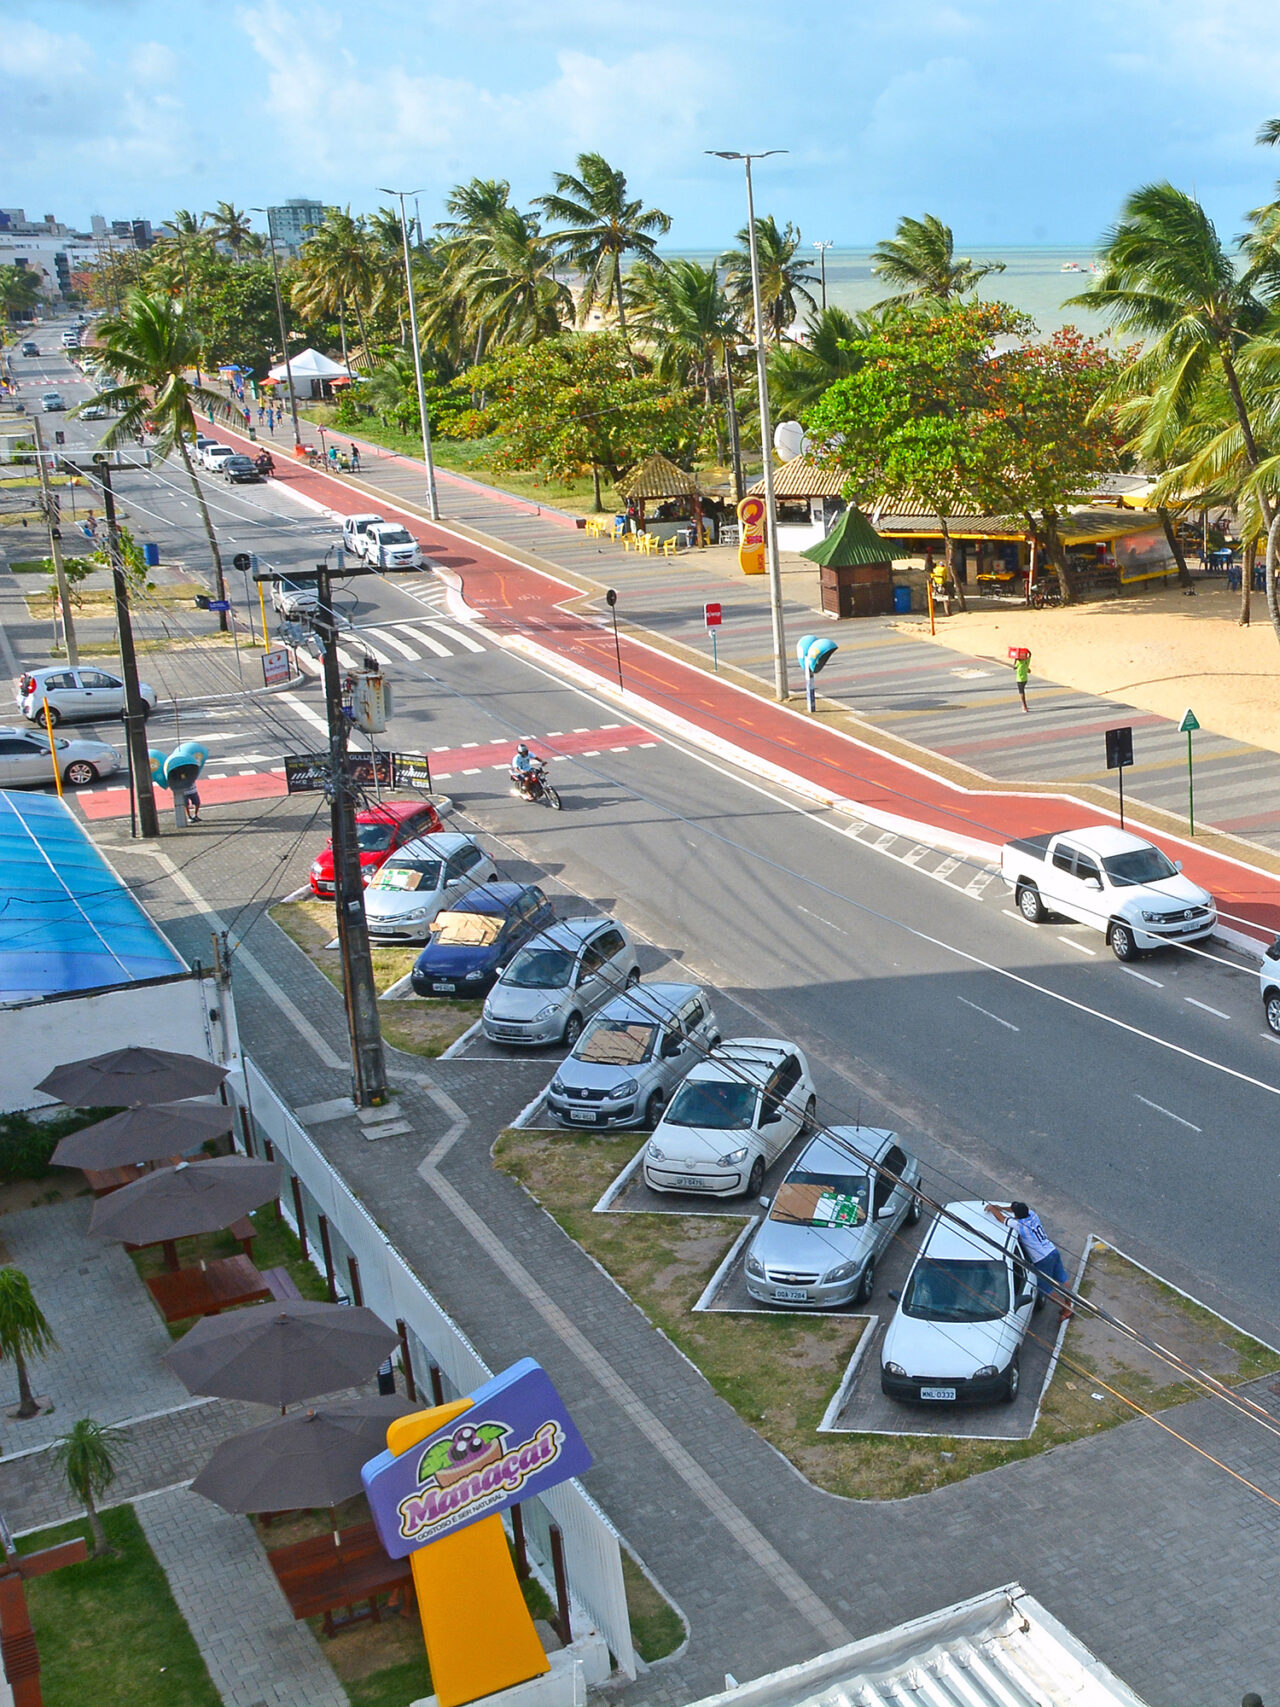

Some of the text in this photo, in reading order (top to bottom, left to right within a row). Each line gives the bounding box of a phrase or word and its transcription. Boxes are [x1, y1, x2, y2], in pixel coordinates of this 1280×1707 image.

[417, 1519, 452, 1541] GOSTOSO
[458, 1508, 473, 1519] SER
[472, 1493, 504, 1513] NATURAL
